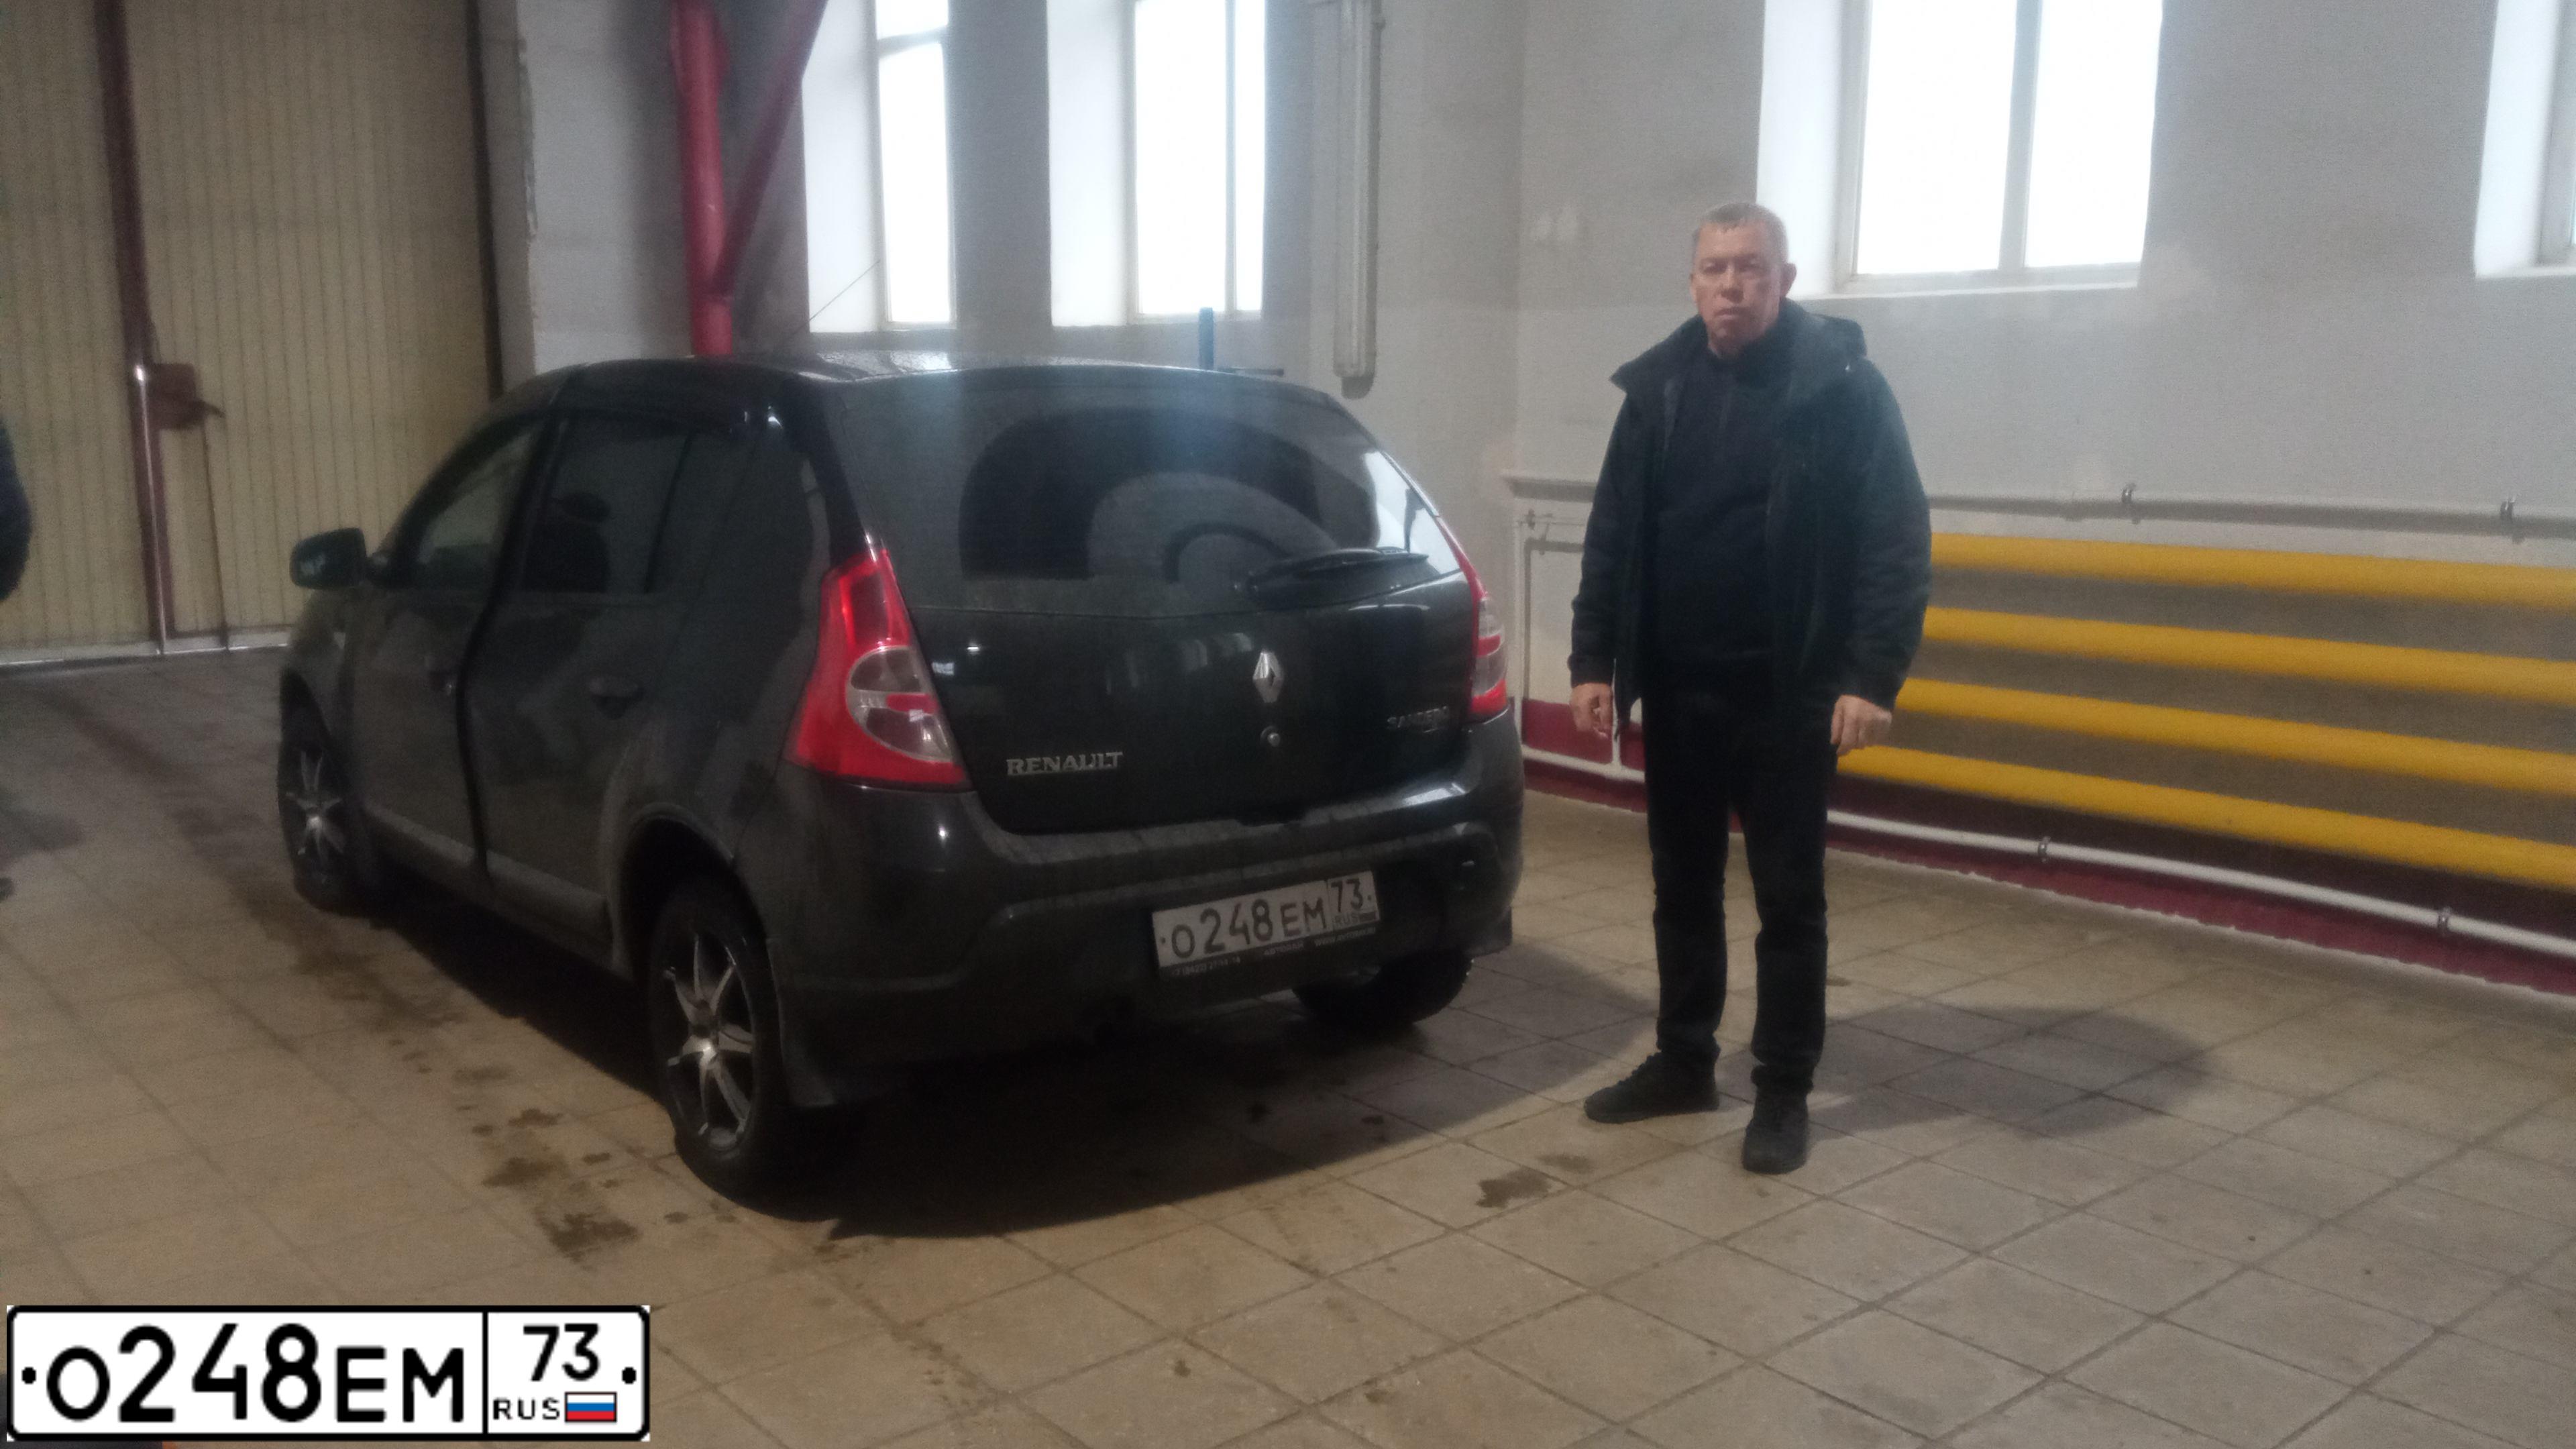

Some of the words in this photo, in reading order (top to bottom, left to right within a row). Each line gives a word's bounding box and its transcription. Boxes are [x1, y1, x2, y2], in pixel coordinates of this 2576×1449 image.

[1006, 751, 1123, 775] RENAULT
[1330, 879, 1364, 913] 73
[1334, 910, 1359, 928] RUS
